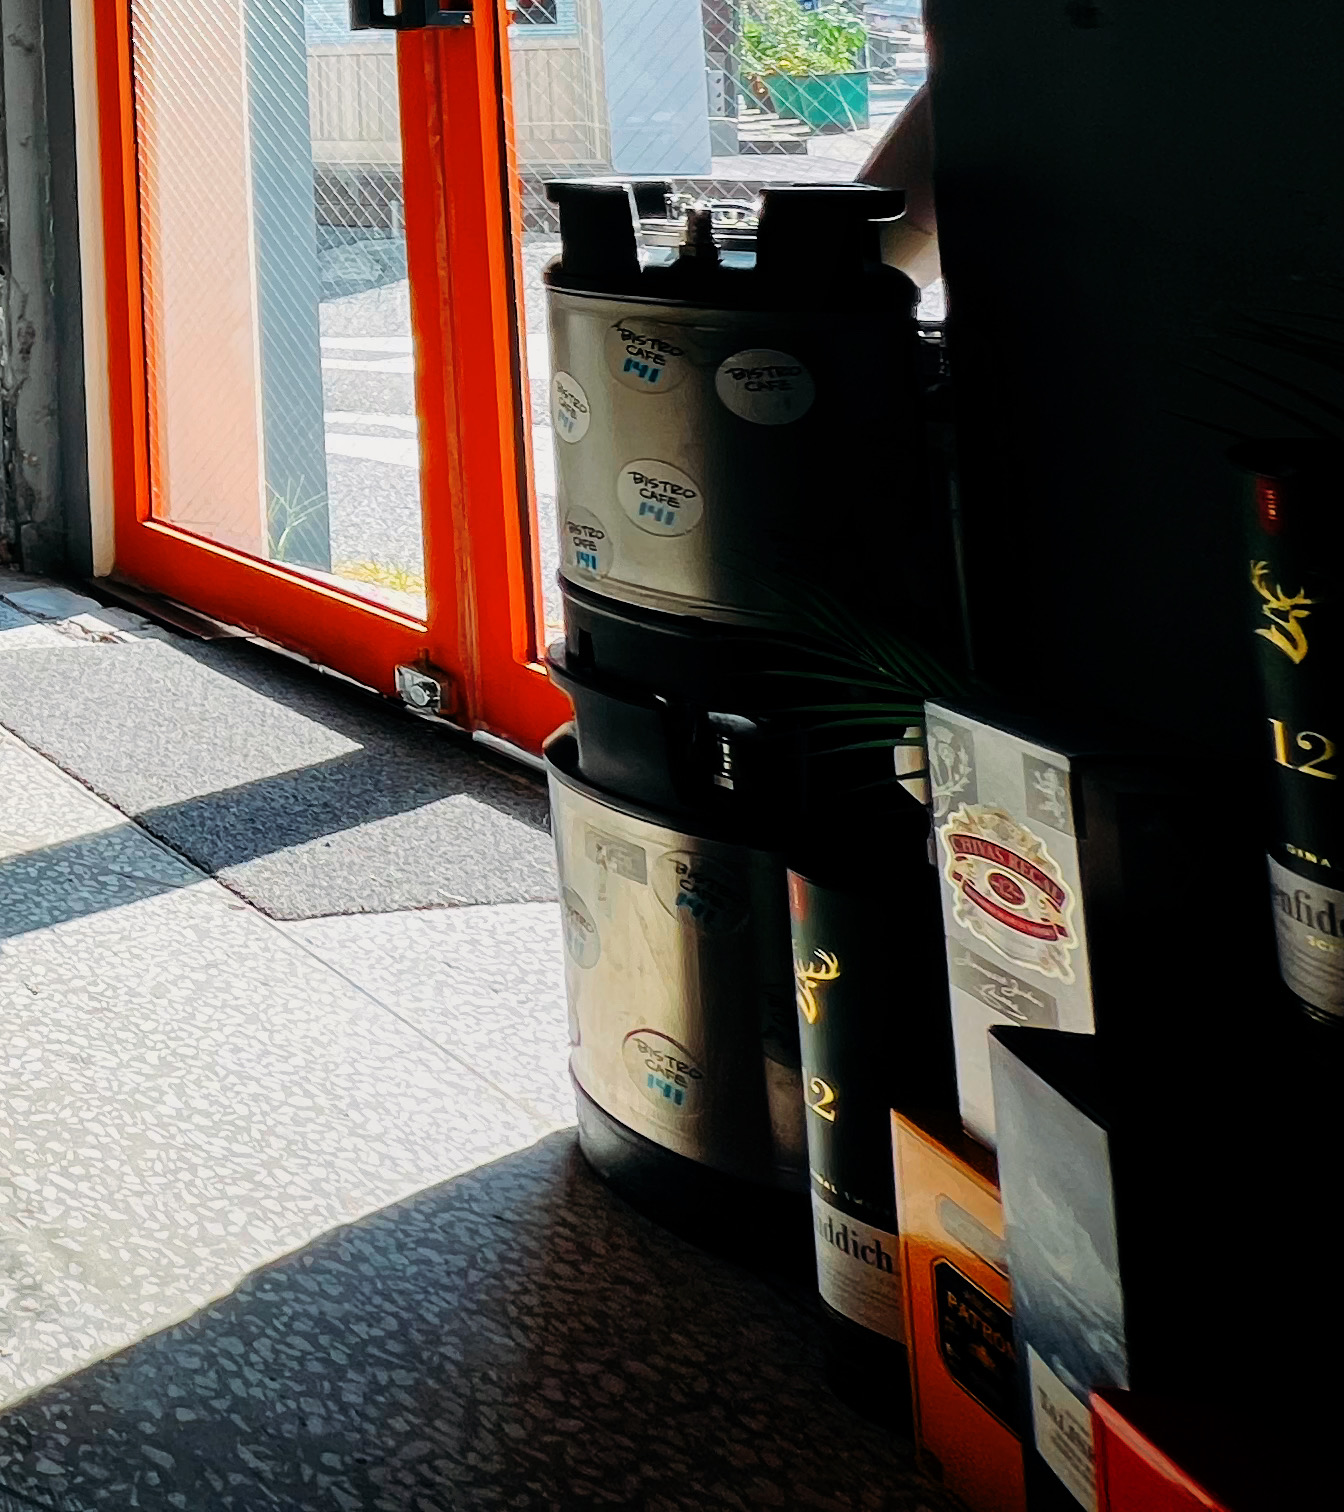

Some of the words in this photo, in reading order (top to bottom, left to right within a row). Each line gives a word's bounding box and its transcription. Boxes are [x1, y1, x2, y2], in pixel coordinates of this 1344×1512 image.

[617, 326, 685, 357] BISTRO
[625, 345, 666, 366] CAFE
[623, 357, 662, 384] 141
[627, 470, 697, 499] BISTRO
[639, 488, 680, 509] CAFE
[638, 501, 676, 526] 141
[1268, 718, 1337, 780] 12
[632, 1037, 703, 1081] BISTRO
